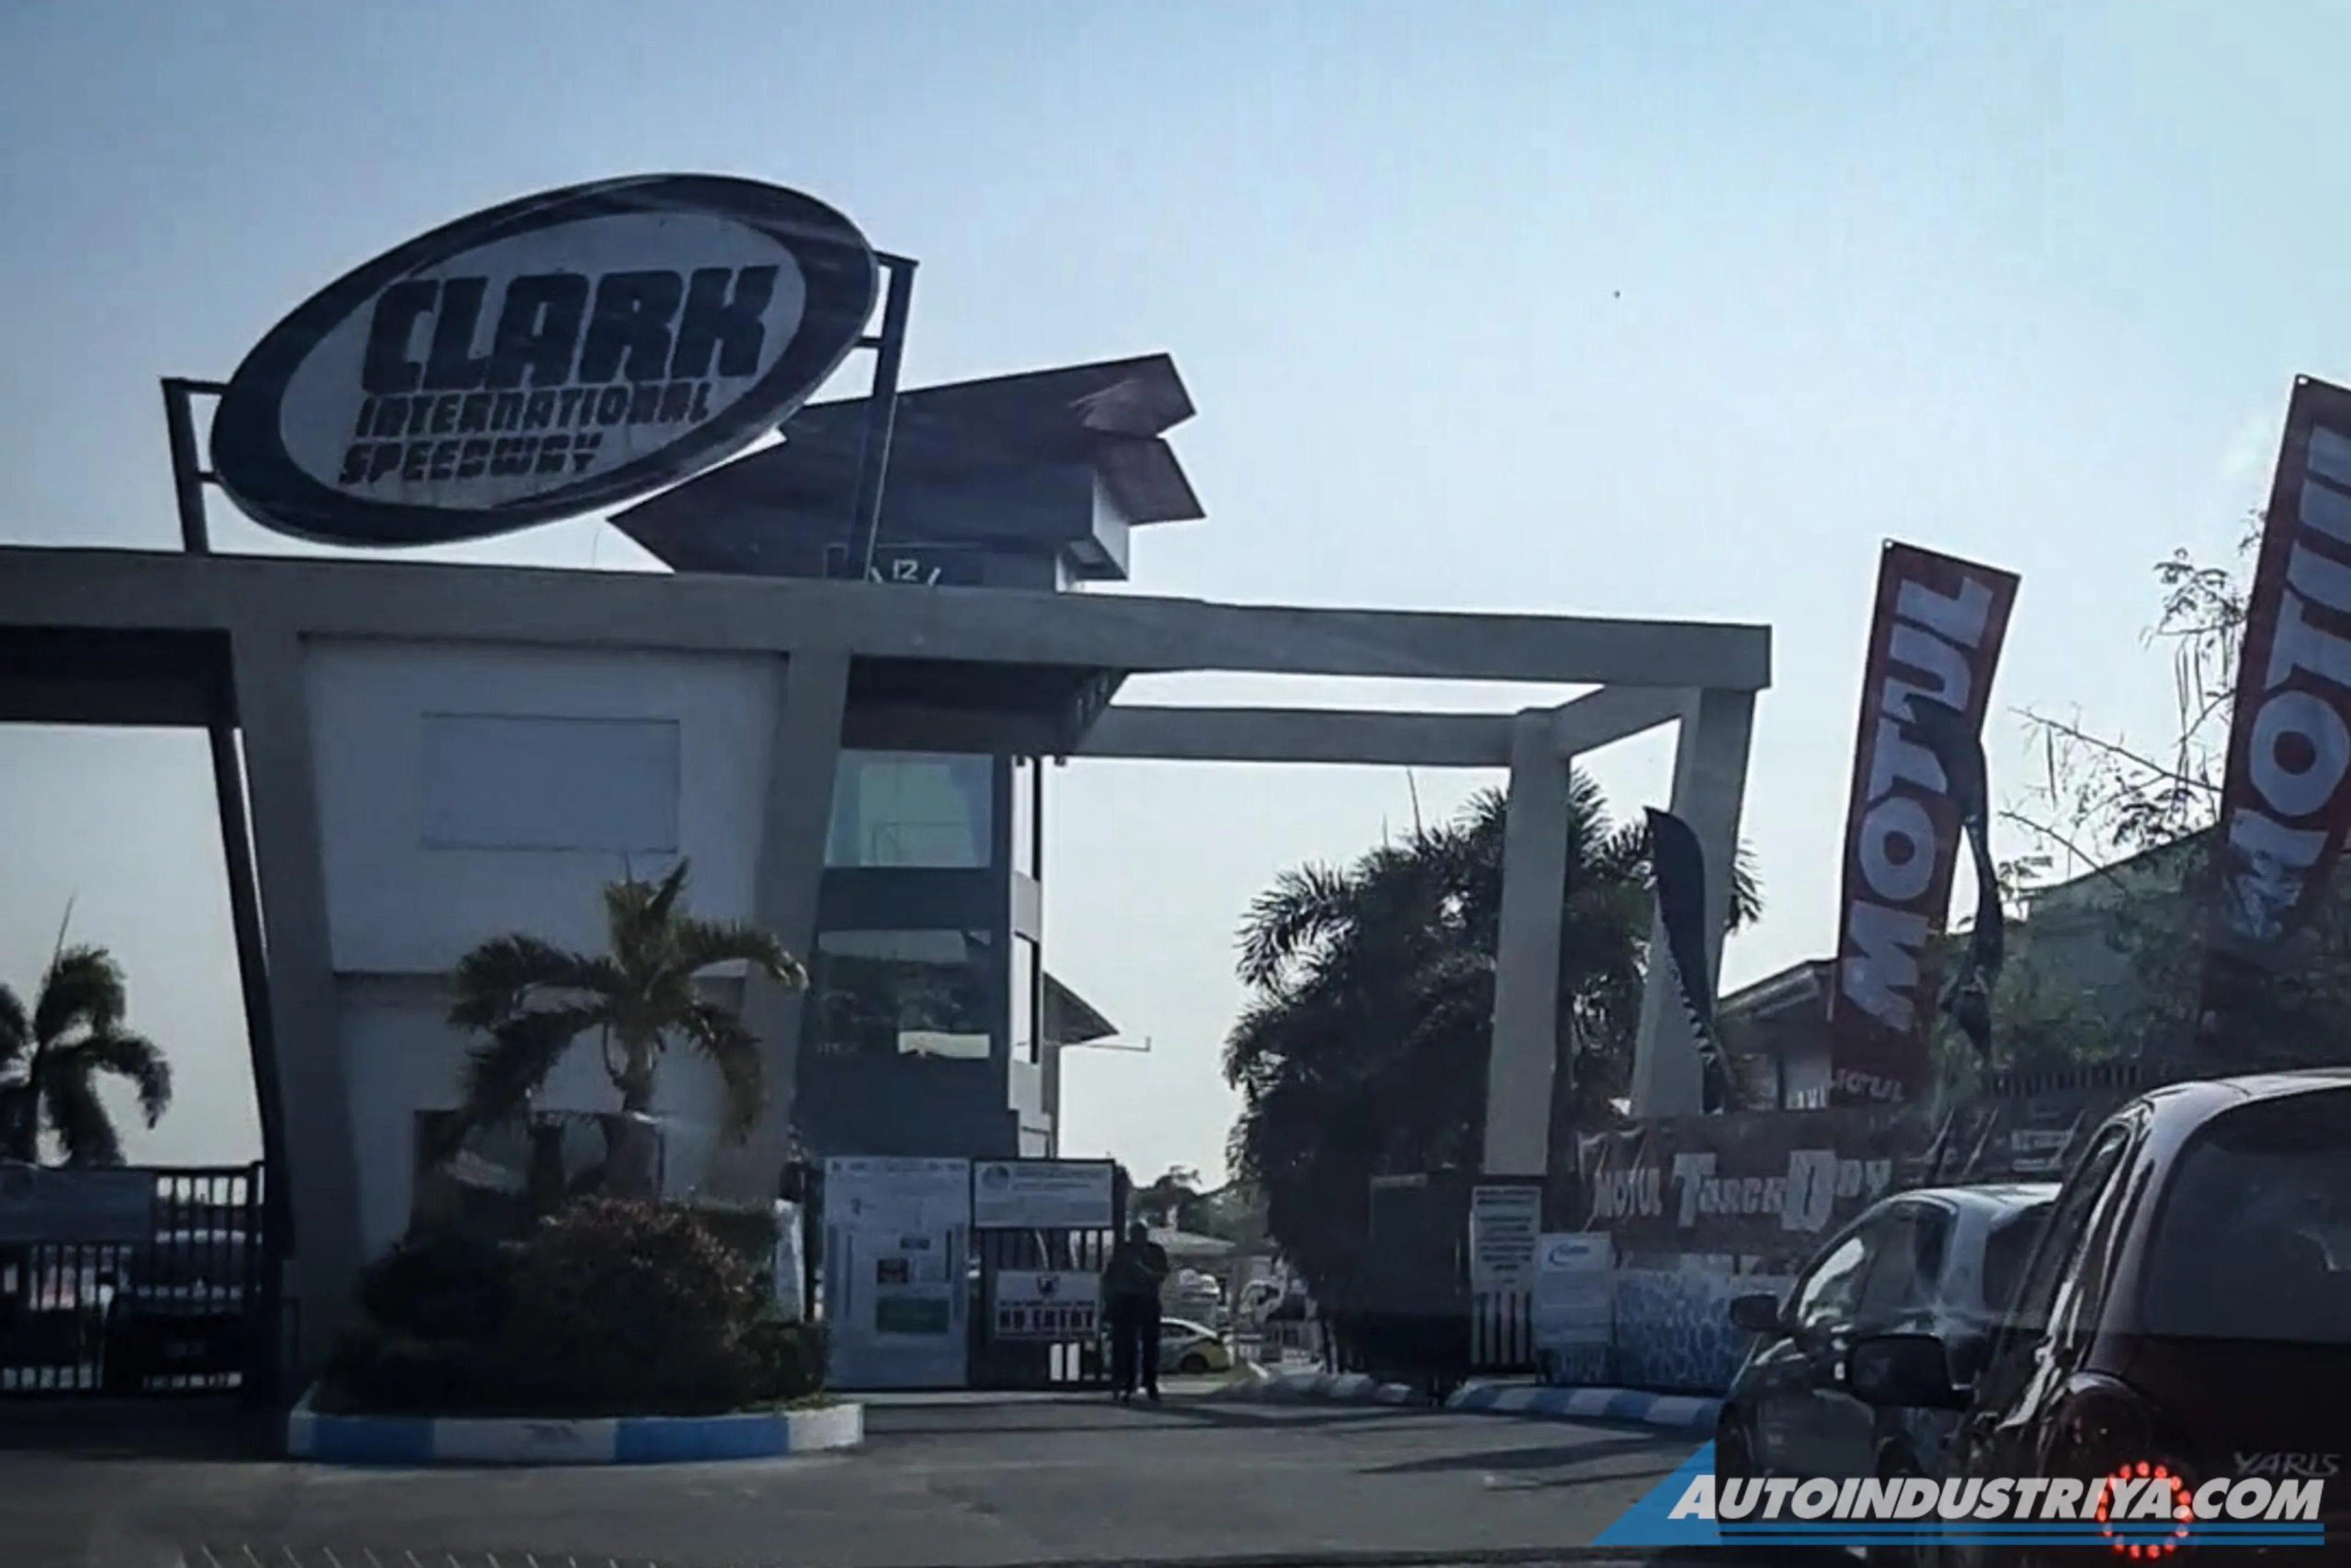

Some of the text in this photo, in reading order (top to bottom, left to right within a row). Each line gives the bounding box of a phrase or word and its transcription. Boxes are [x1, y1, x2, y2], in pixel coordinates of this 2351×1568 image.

[362, 265, 780, 395] CLARK
[355, 381, 713, 437] INTERNATIONAL
[339, 432, 604, 484] SPEEDWAY
[892, 558, 918, 580] 12
[1842, 576, 1993, 1032] MOTUL
[1594, 1168, 1662, 1218] MOTUL
[2233, 1451, 2342, 1477] YARIS
